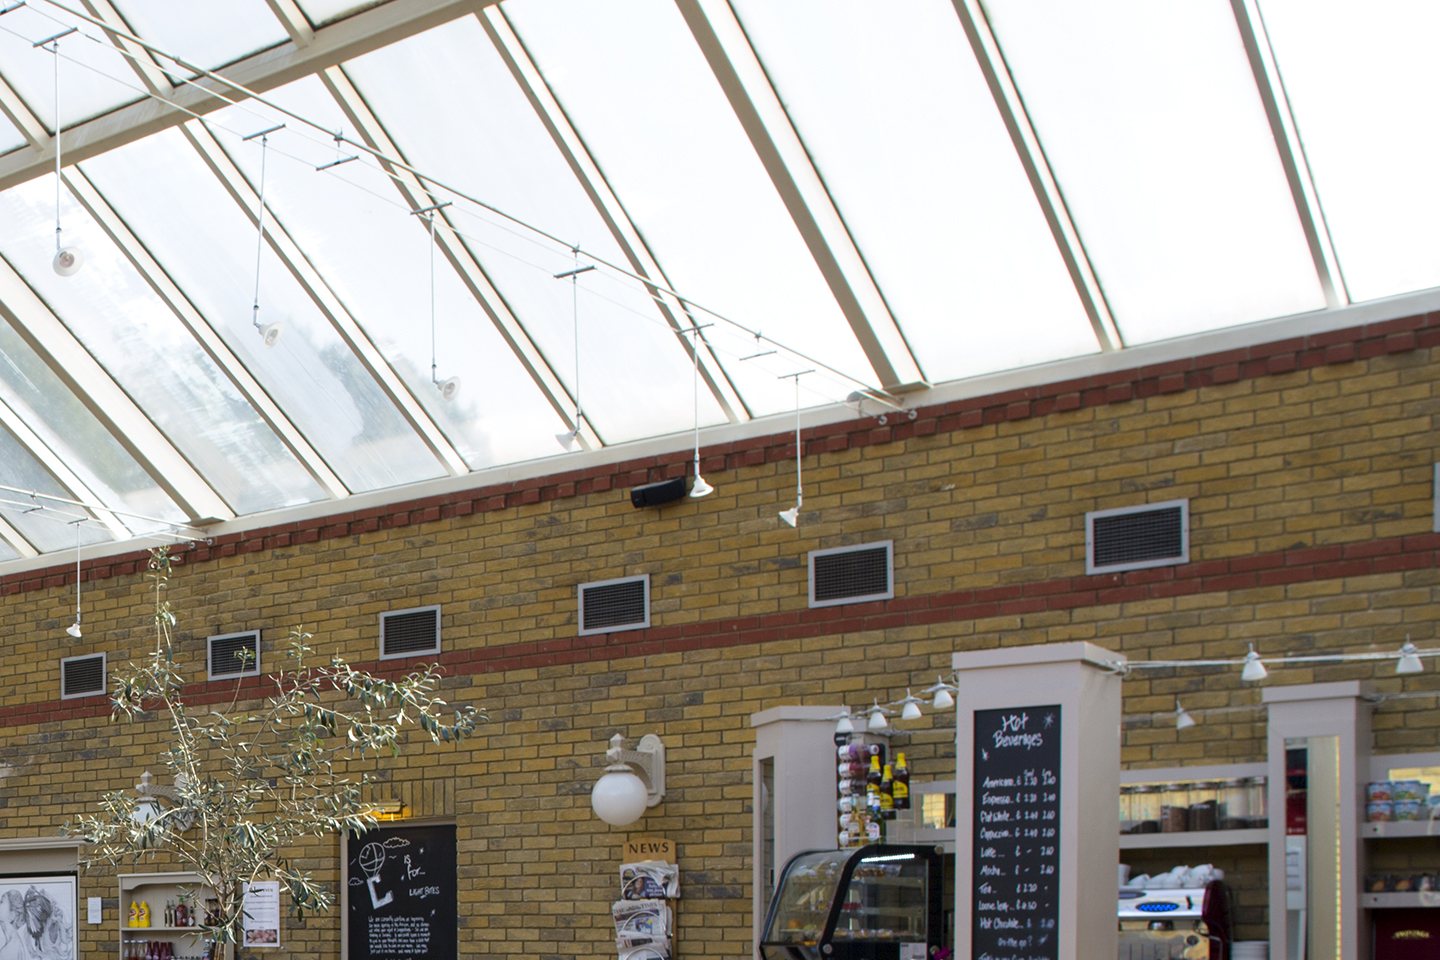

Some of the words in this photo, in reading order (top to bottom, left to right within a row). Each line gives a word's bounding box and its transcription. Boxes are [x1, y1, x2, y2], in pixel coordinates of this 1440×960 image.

[1002, 712, 1029, 732] Hot
[992, 729, 1043, 750] Beverages
[629, 842, 669, 854] NEWS
